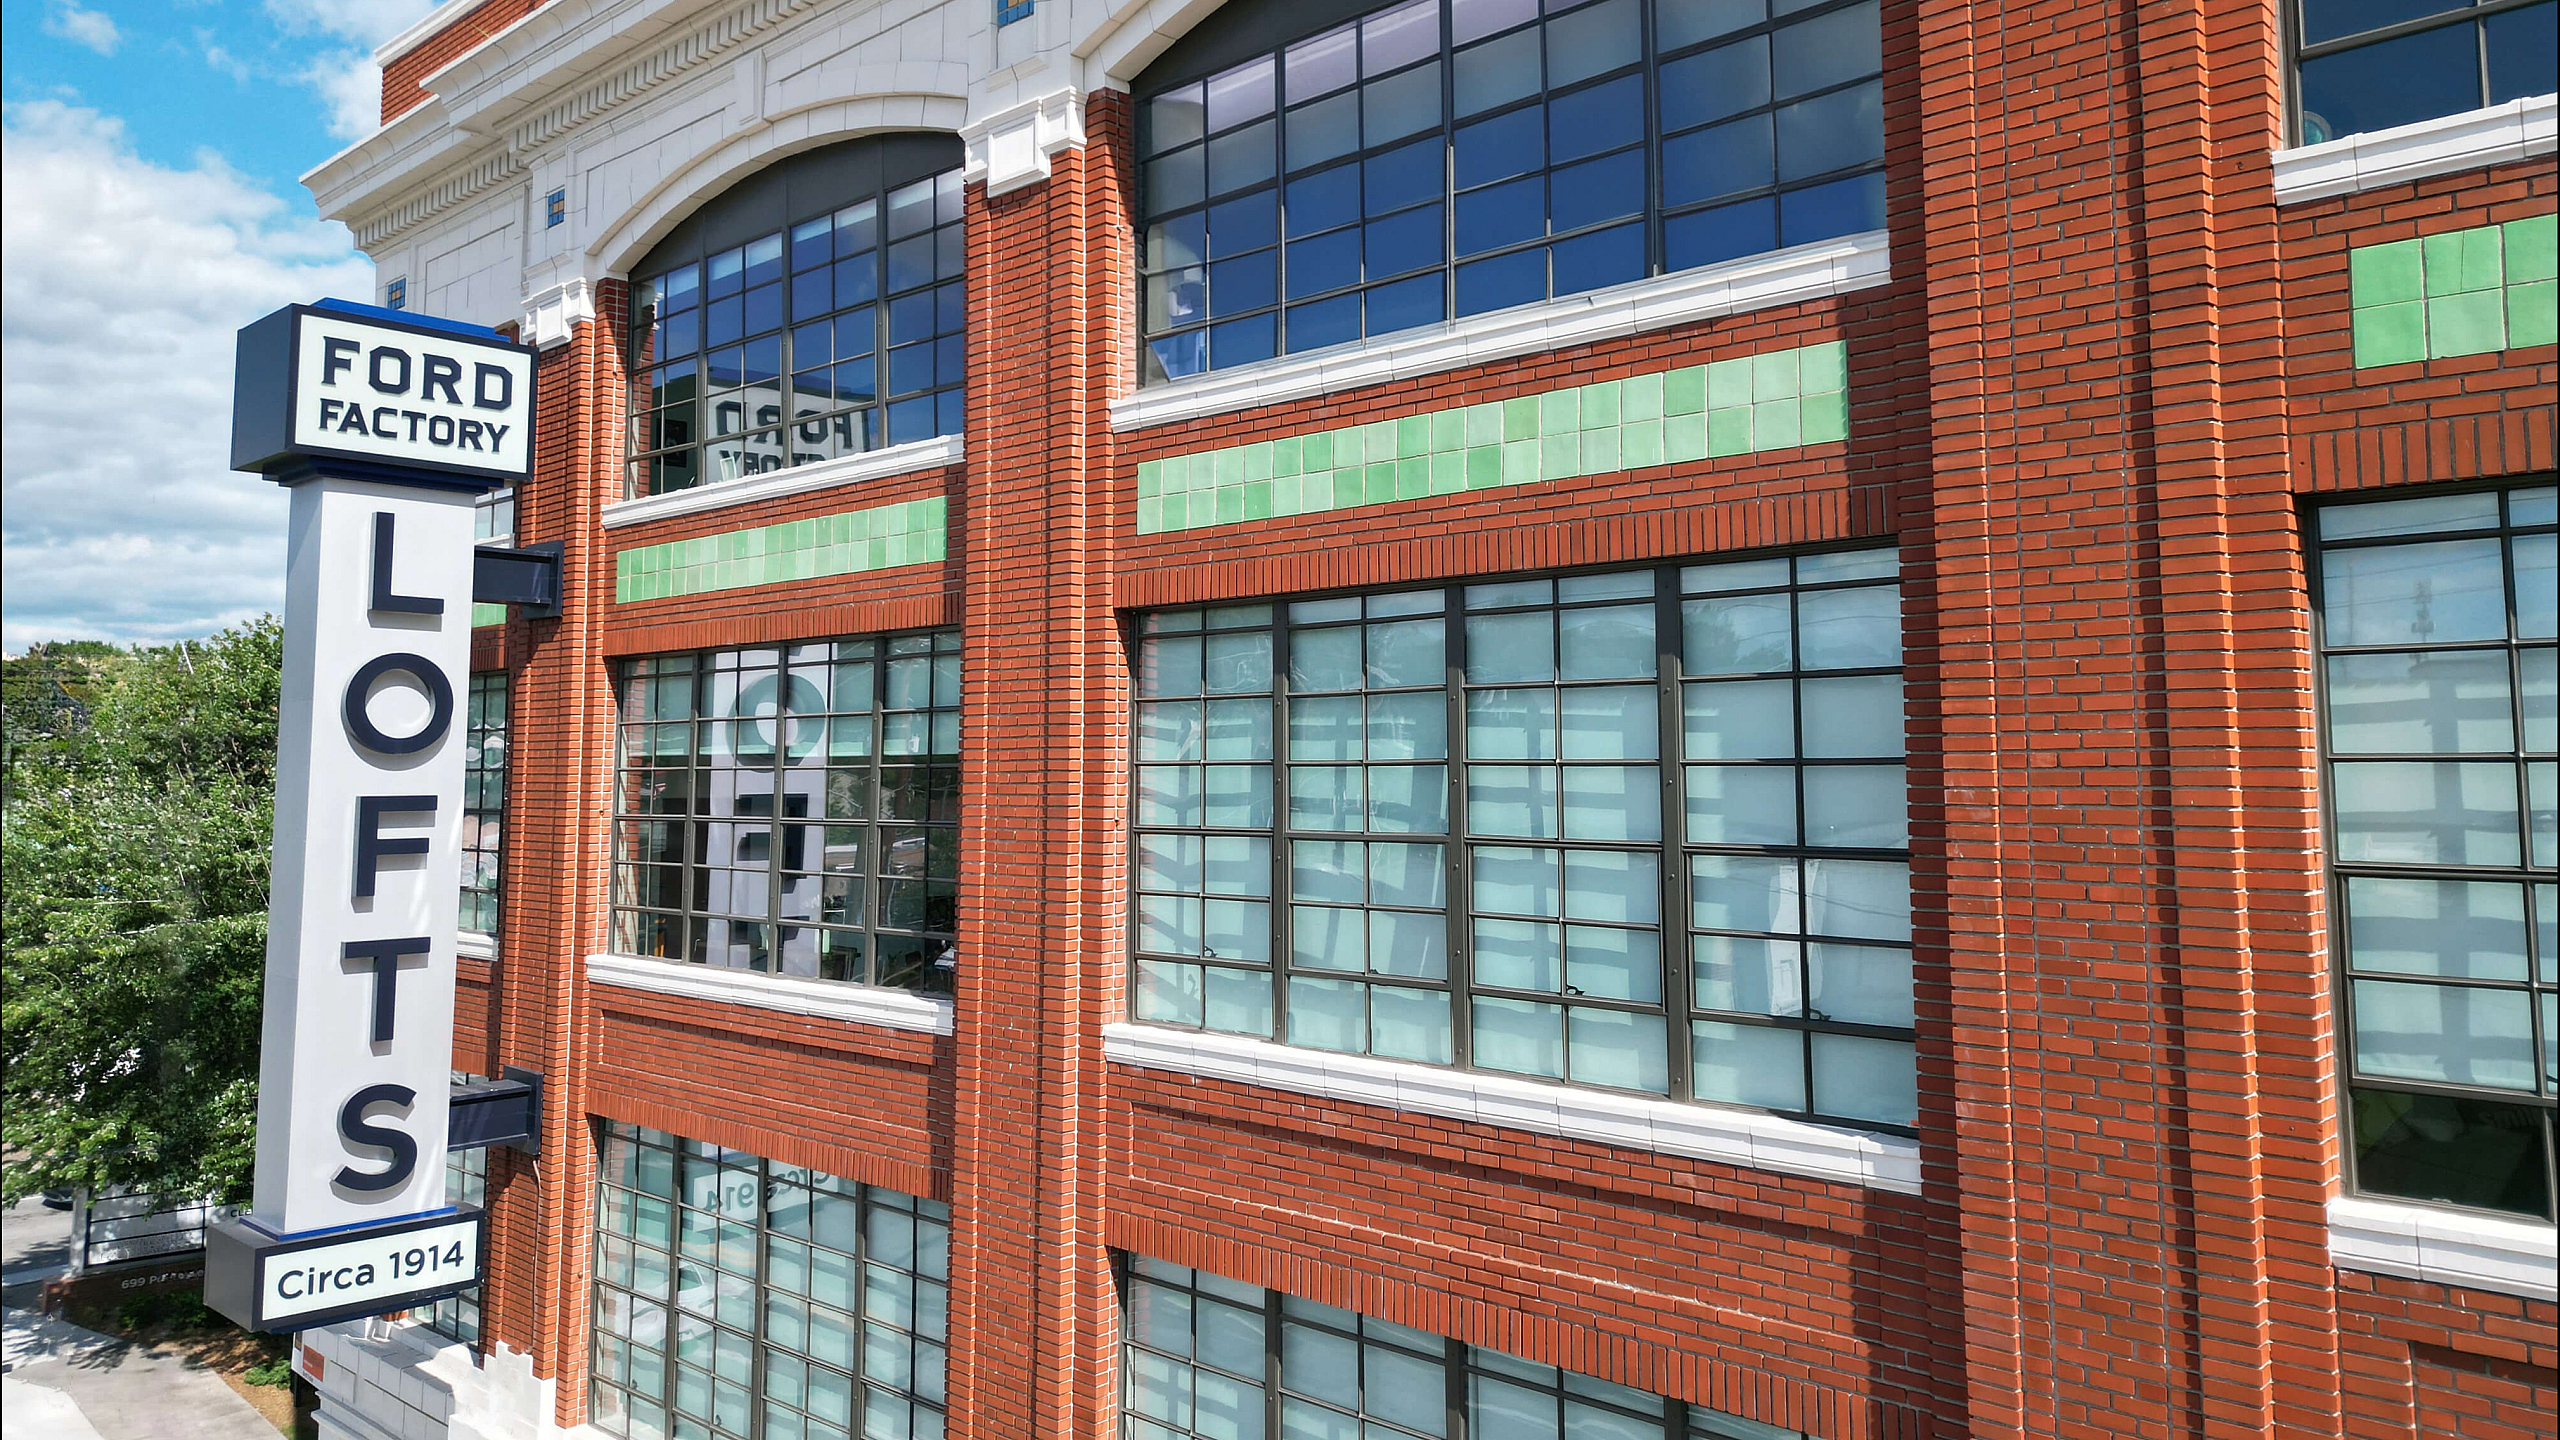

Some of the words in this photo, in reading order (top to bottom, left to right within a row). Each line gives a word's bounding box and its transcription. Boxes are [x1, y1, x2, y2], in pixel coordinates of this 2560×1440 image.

[321, 336, 513, 411] FORD
[318, 398, 510, 453] FACTORY
[332, 511, 454, 1192] LOFTS
[121, 1277, 146, 1289] 699
[278, 1263, 375, 1299] Circa
[389, 1240, 464, 1279] 1914
